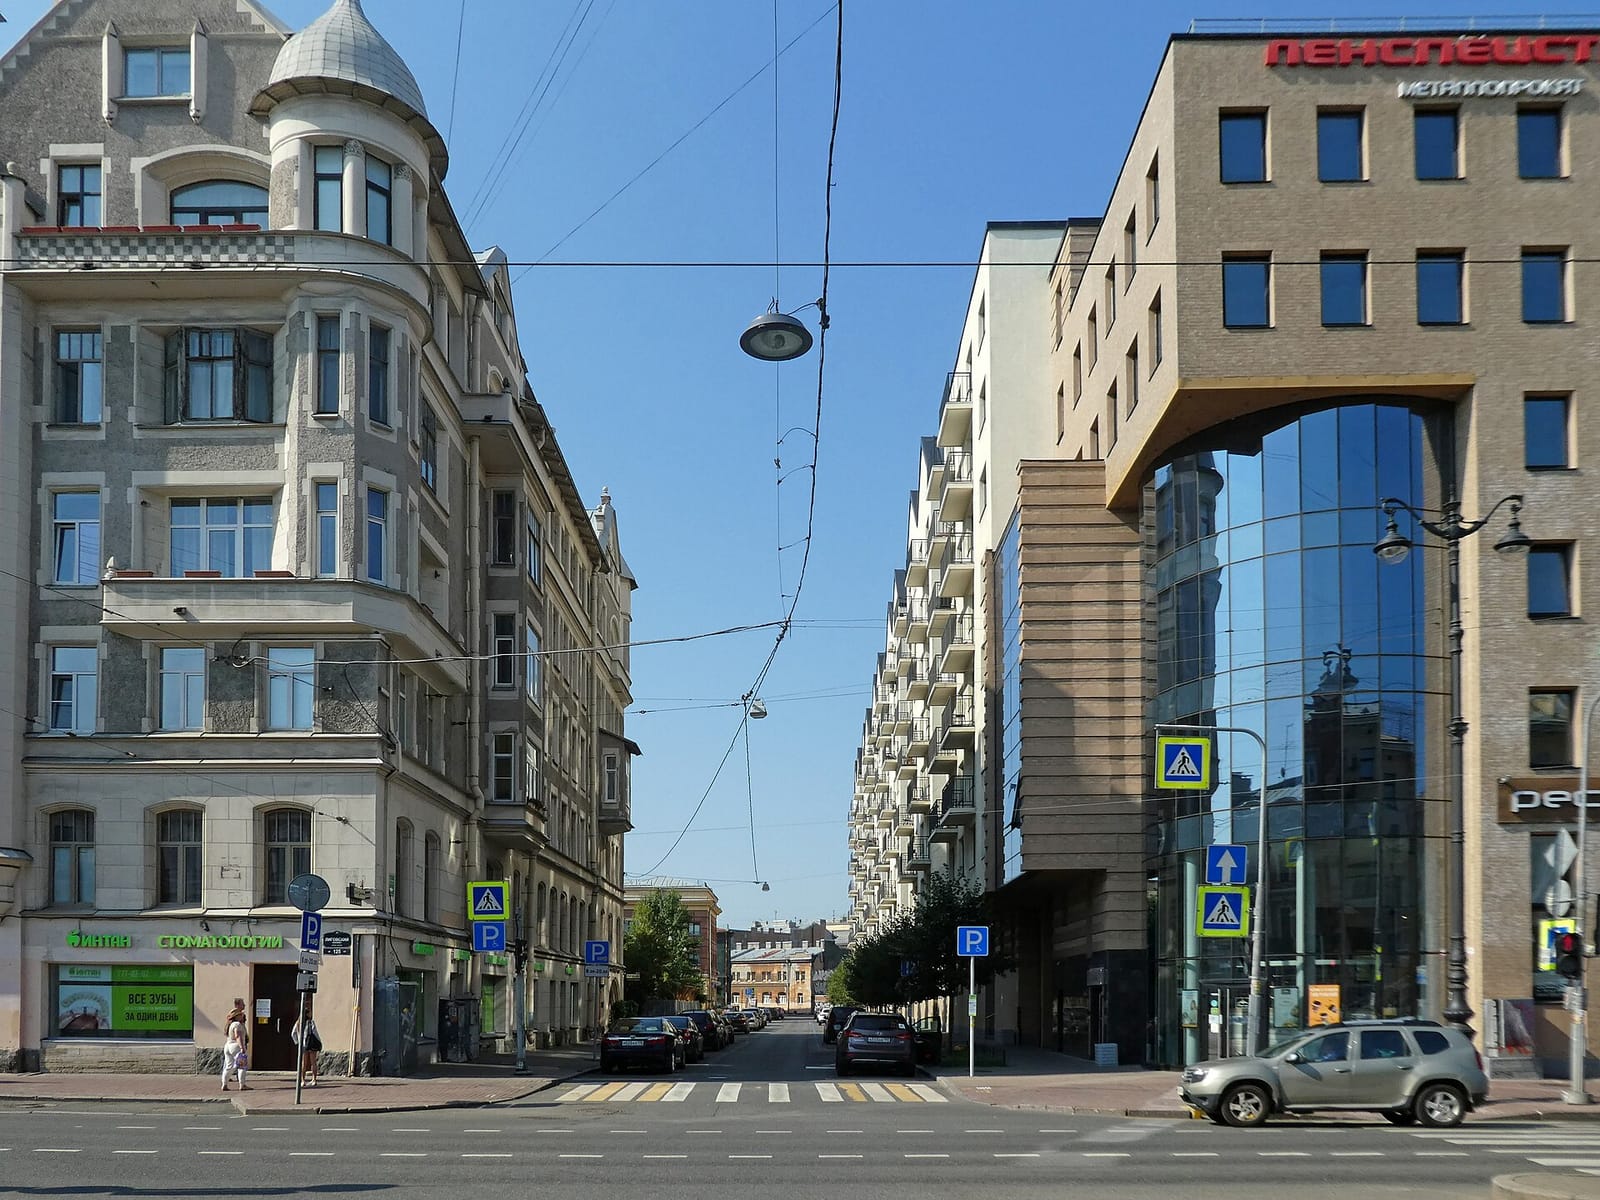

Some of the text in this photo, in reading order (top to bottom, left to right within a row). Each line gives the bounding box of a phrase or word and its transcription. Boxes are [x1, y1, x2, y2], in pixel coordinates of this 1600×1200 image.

[157, 934, 283, 949] СТОМАТОЛОГИИ
[128, 993, 176, 1005] ВСЕ ЗУБЫ
[125, 1012, 179, 1022] ЗА ОДИН ДЕНЬ
